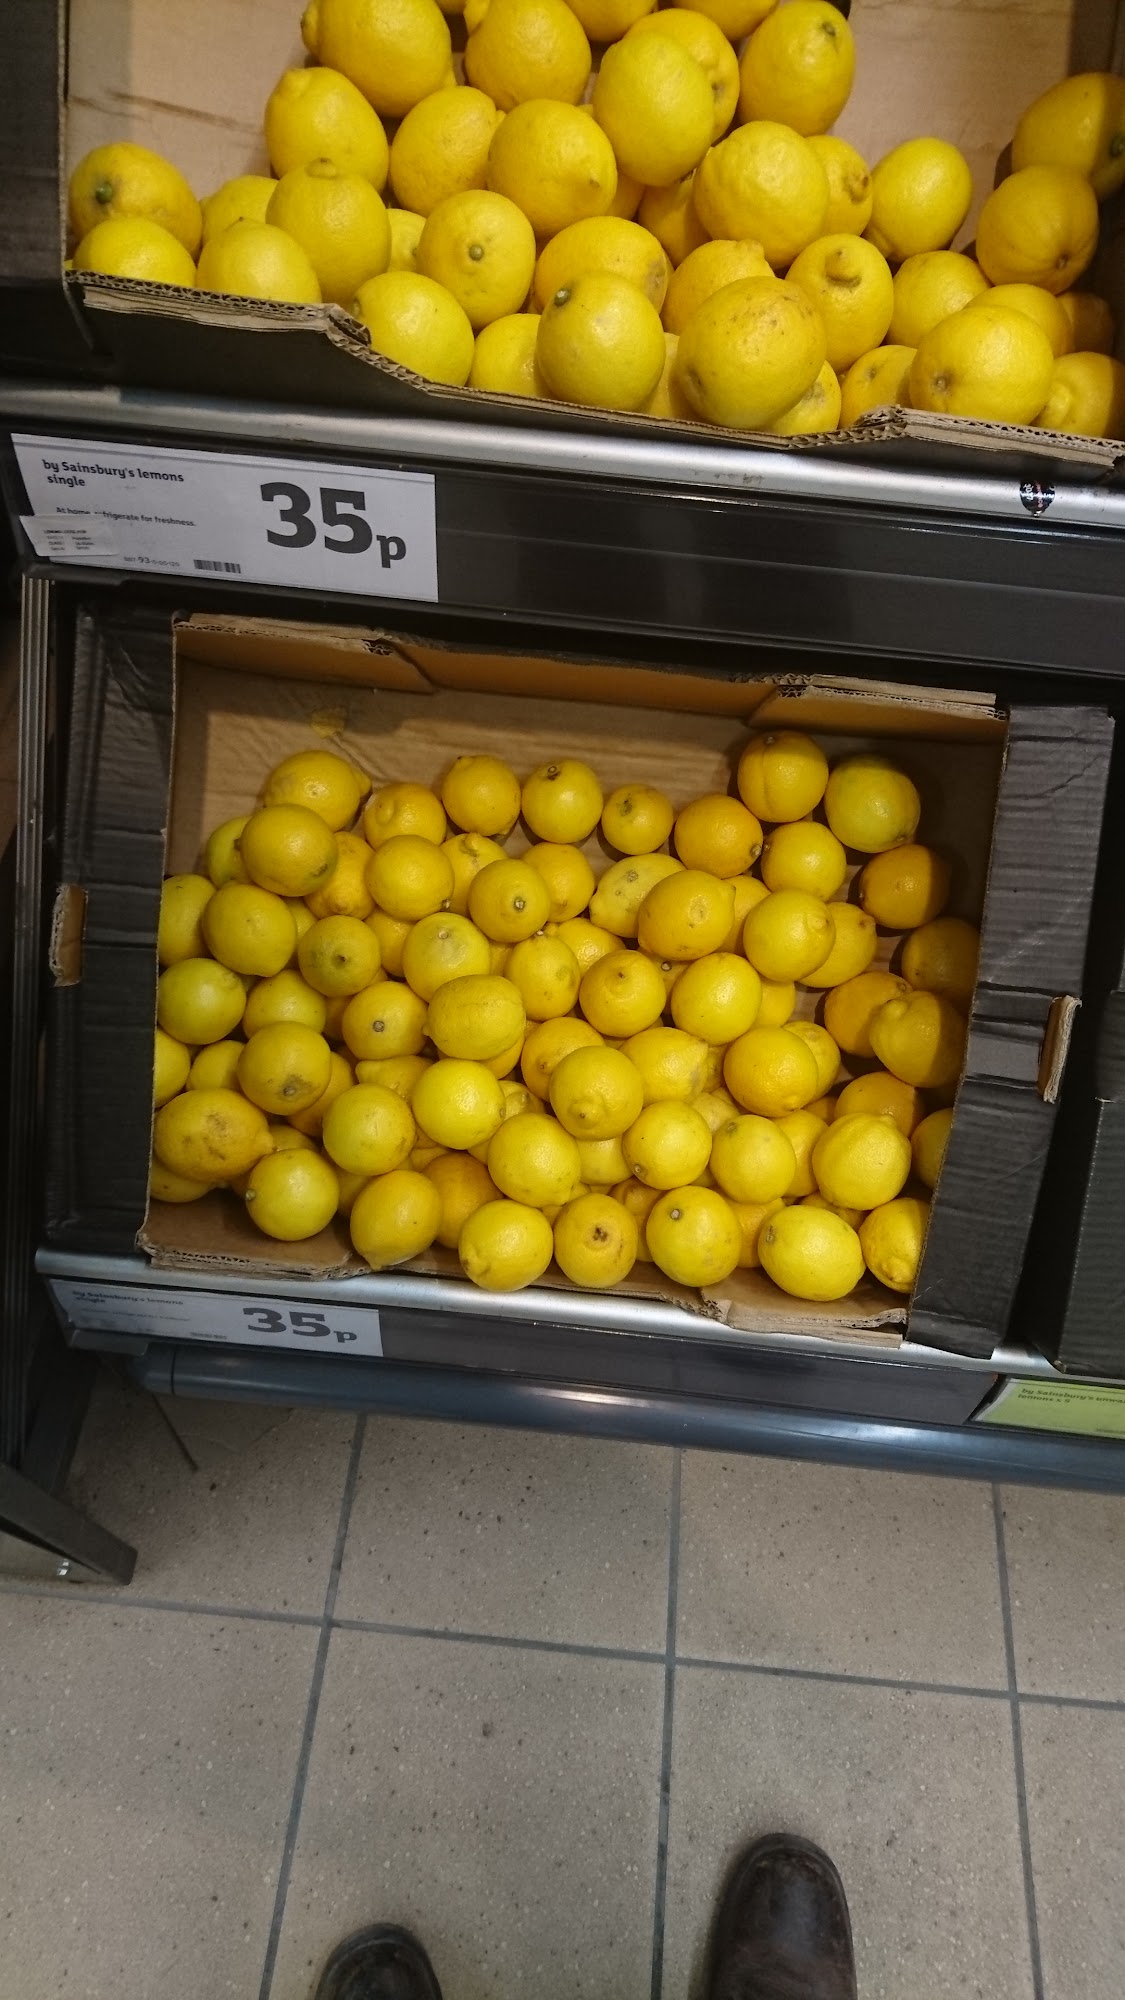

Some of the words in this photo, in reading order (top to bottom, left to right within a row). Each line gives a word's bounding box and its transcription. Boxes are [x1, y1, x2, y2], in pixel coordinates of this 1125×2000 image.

[42, 459, 60, 473] by
[61, 461, 136, 479] Sainsbury's
[137, 468, 185, 482] lemons
[47, 474, 86, 488] single
[1037, 1390, 1094, 1400] Sainsbury's
